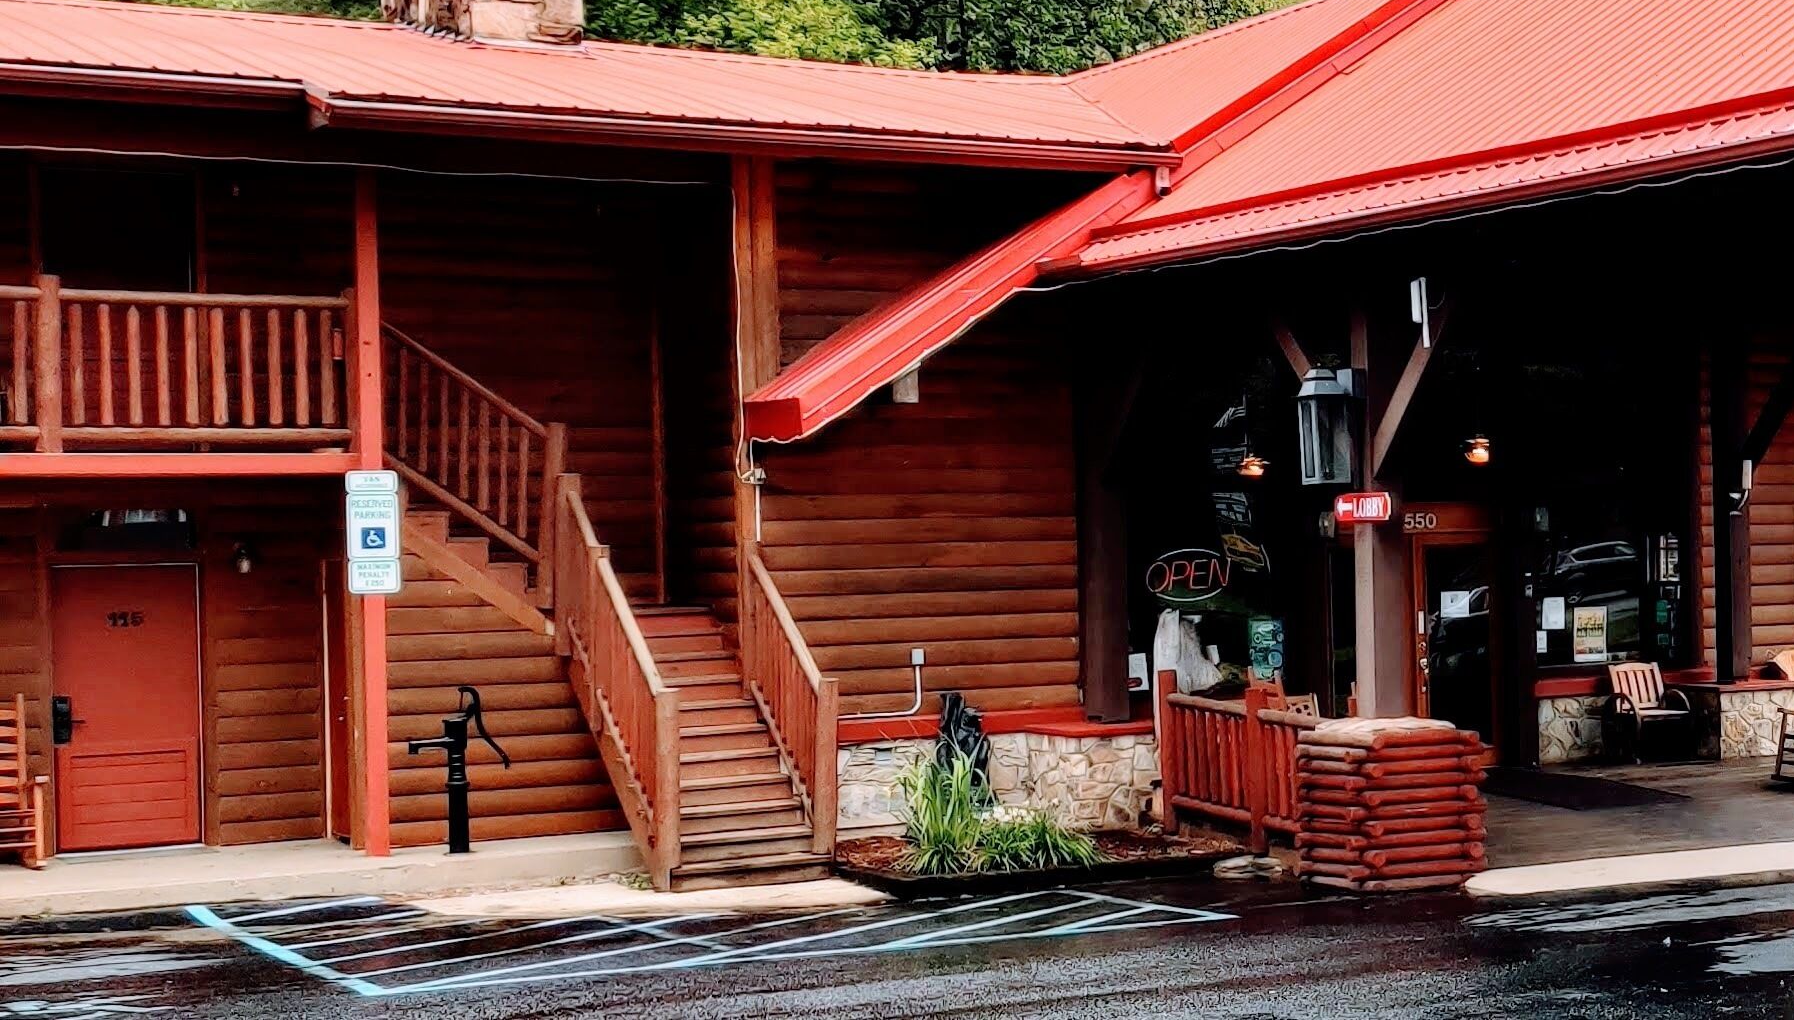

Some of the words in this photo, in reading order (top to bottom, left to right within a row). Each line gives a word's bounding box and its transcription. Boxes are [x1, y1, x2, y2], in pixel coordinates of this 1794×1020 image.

[352, 499, 393, 508] RESERVED
[1352, 497, 1385, 518] LOBBY
[354, 510, 392, 520] PARKING
[1404, 513, 1437, 529] 550
[1146, 557, 1231, 592] OPEN
